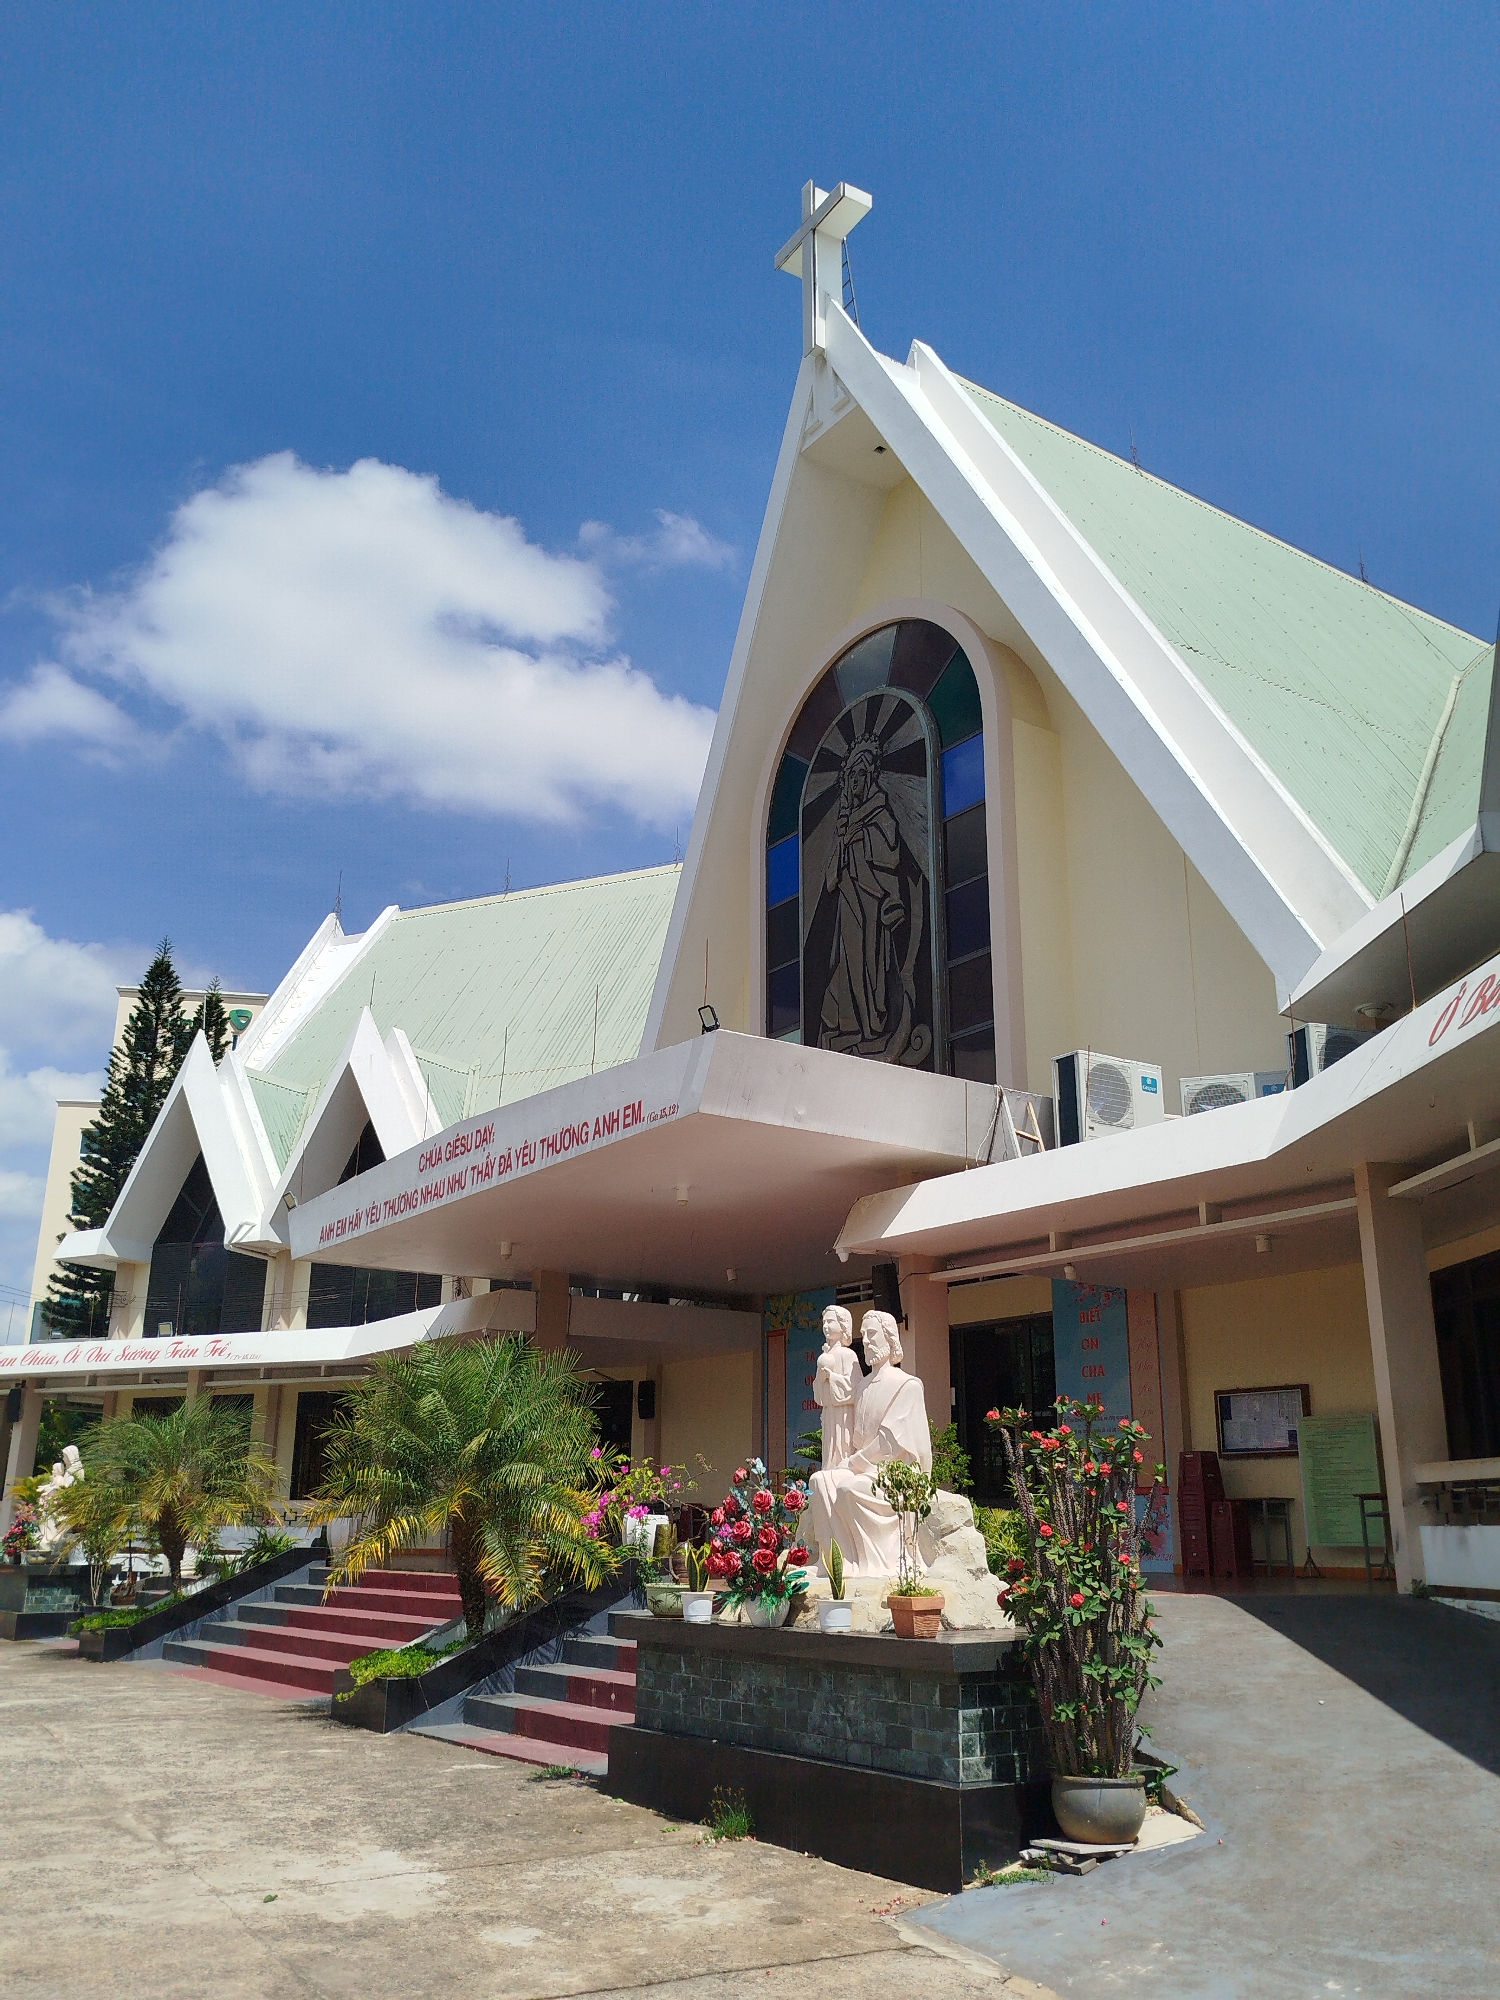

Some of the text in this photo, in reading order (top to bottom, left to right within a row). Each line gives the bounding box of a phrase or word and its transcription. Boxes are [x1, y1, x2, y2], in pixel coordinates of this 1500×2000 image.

[418, 1122, 496, 1173] CHÚA GIÊSU DẠY:
[319, 1221, 336, 1244] ANH
[336, 1216, 347, 1237] EM
[348, 1208, 363, 1232] HÃY
[366, 1201, 382, 1227] YÊU
[383, 1188, 419, 1220] THƯƠNG
[419, 1178, 446, 1205] NHAU
[447, 1173, 468, 1195] NHƯ
[471, 1151, 496, 1187] THẦY
[498, 1146, 513, 1176] ĐÃ
[515, 1139, 538, 1170] YÊU
[539, 1121, 590, 1160] THƯƠNG
[592, 1108, 621, 1142] ANH
[622, 1099, 645, 1130] EM.
[1079, 1305, 1102, 1324] BIẾT
[20, 1349, 60, 1368] Chúa,
[84, 1346, 114, 1363] Vui
[115, 1345, 161, 1364] Sướng
[165, 1341, 200, 1359] Tràn
[1081, 1364, 1106, 1378] CHA
